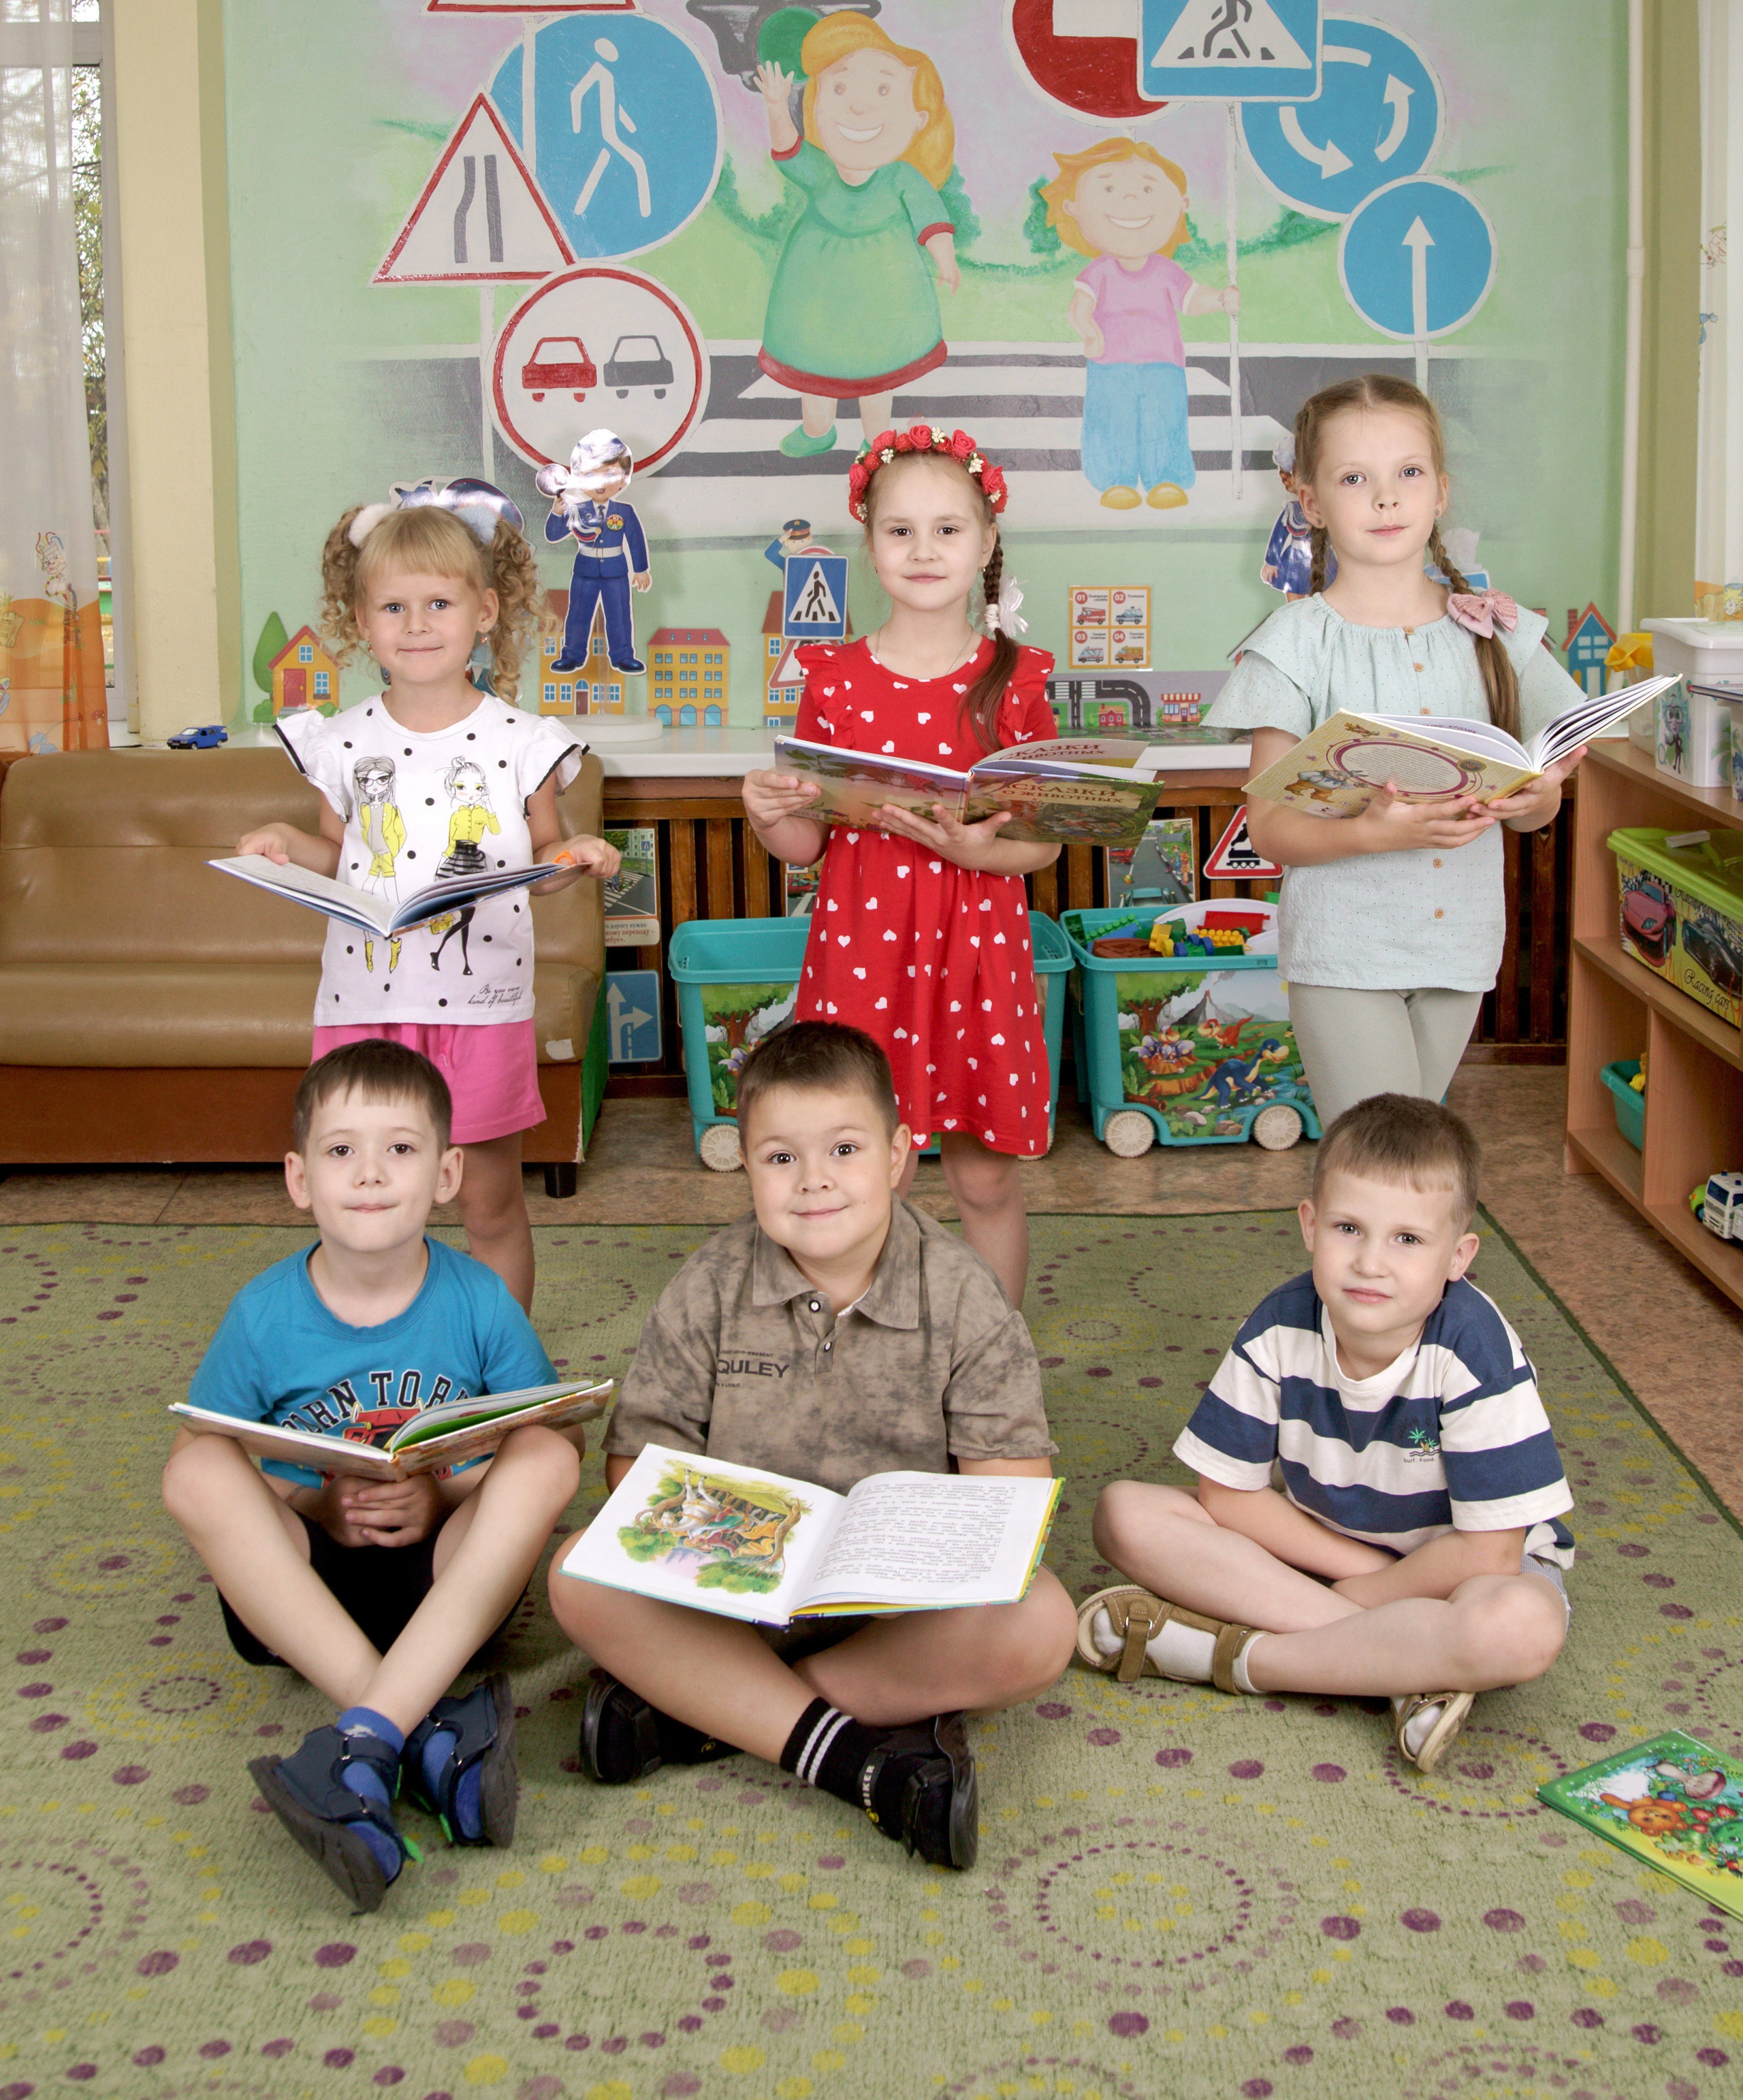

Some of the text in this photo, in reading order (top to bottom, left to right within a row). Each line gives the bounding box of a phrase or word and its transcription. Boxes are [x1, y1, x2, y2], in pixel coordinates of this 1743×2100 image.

[1011, 783, 1117, 797] СКАЗКИ
[1021, 791, 1123, 803] ЖИВОТНЫХ
[1684, 968, 1731, 1010] Racing cars
[468, 994, 489, 1004] kind
[717, 1359, 790, 1378] QULEY
[862, 1765, 875, 1807] BIKER
